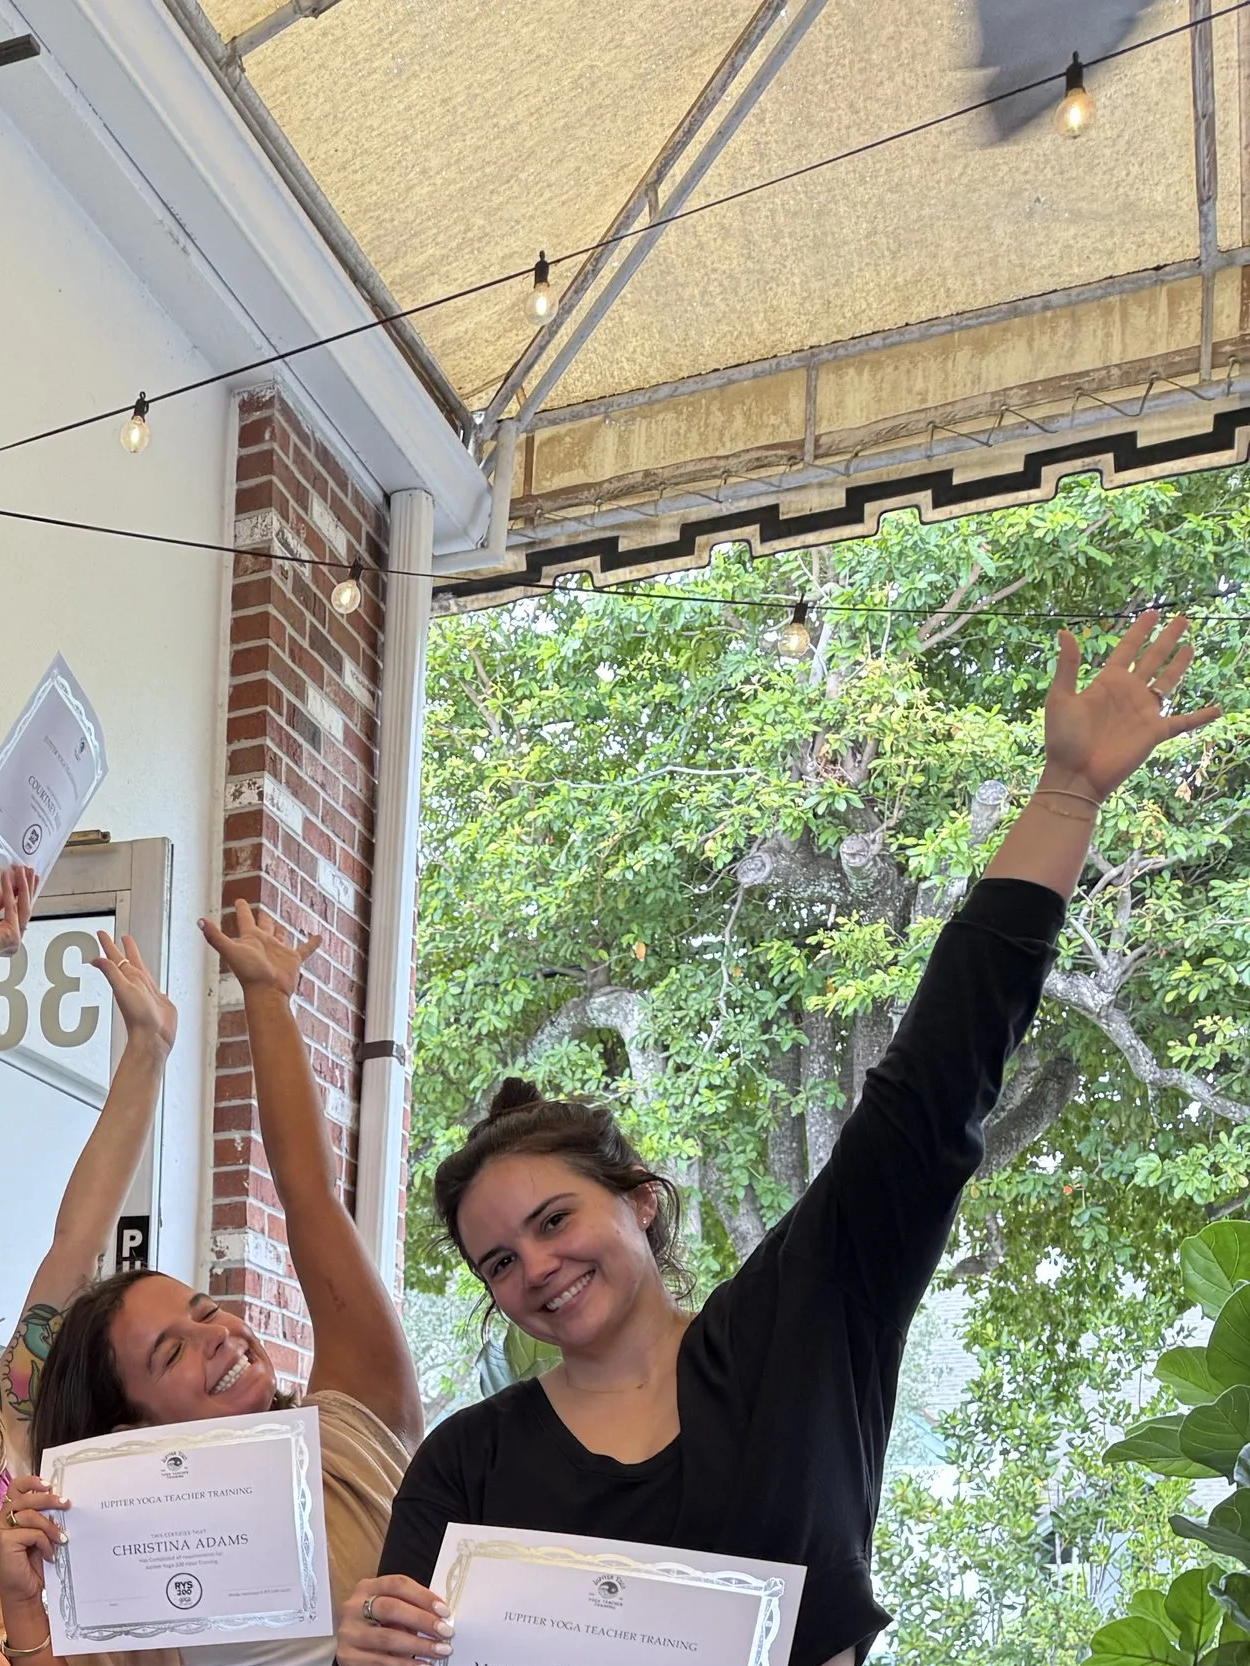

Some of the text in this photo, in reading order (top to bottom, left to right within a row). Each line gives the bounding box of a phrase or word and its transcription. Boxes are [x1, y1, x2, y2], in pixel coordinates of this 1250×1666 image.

[101, 1487, 253, 1509] JUPITER YOGA TEACHER TRAINING
[112, 1534, 249, 1556] CHRISTINA ADAMS
[175, 1581, 193, 1590] RYS
[504, 1611, 698, 1651] JUPITER YOGA TEACHER TRAINING
